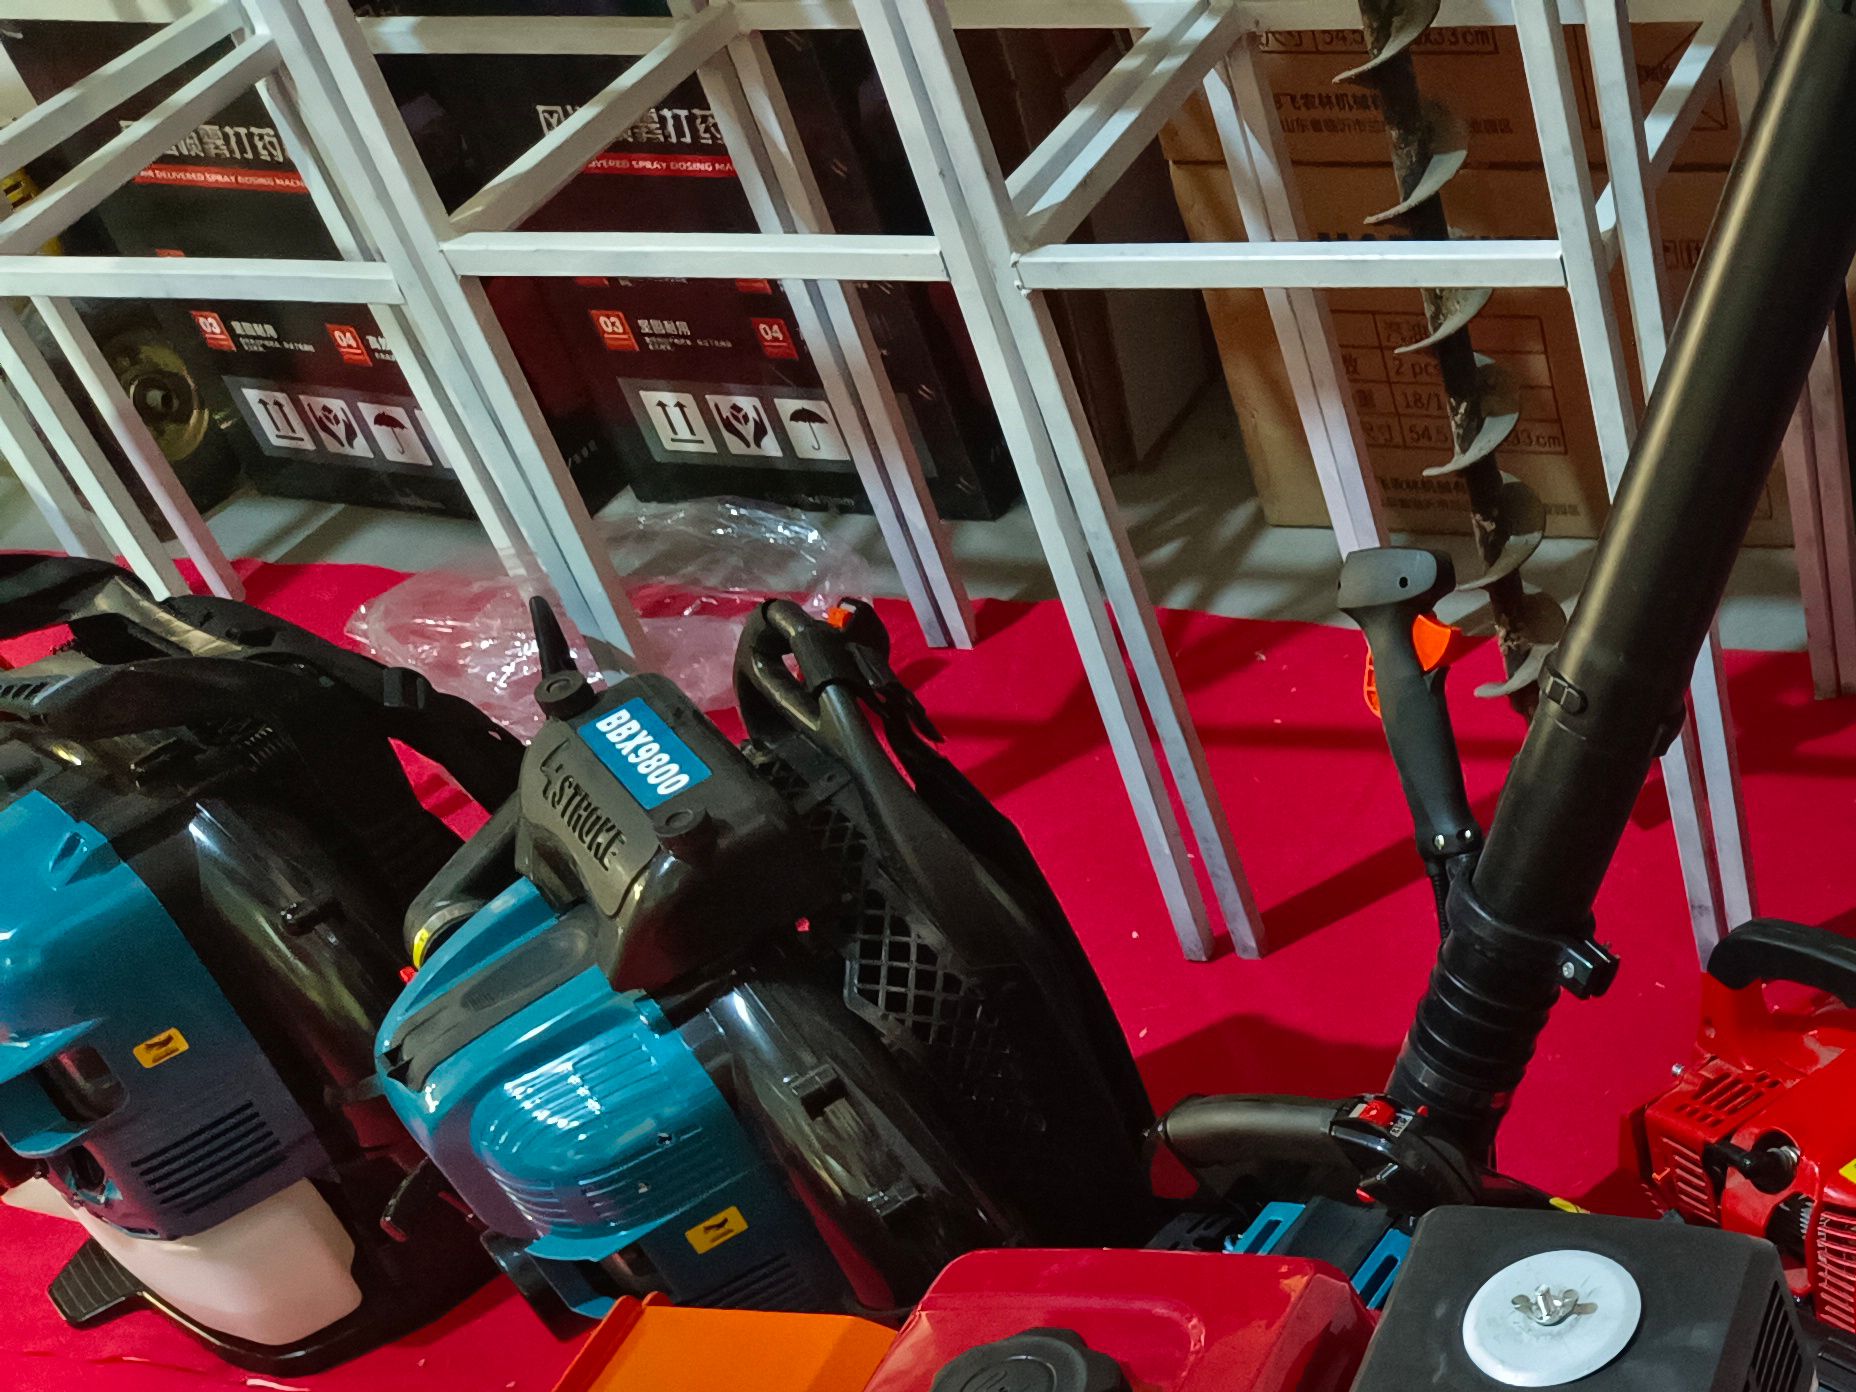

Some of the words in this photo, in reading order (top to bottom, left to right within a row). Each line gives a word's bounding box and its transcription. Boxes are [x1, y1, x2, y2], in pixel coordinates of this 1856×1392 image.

[198, 316, 221, 334] 03
[599, 316, 624, 334] 03
[758, 322, 785, 341] 04
[333, 329, 357, 348] 04
[595, 708, 690, 796] BBX9800
